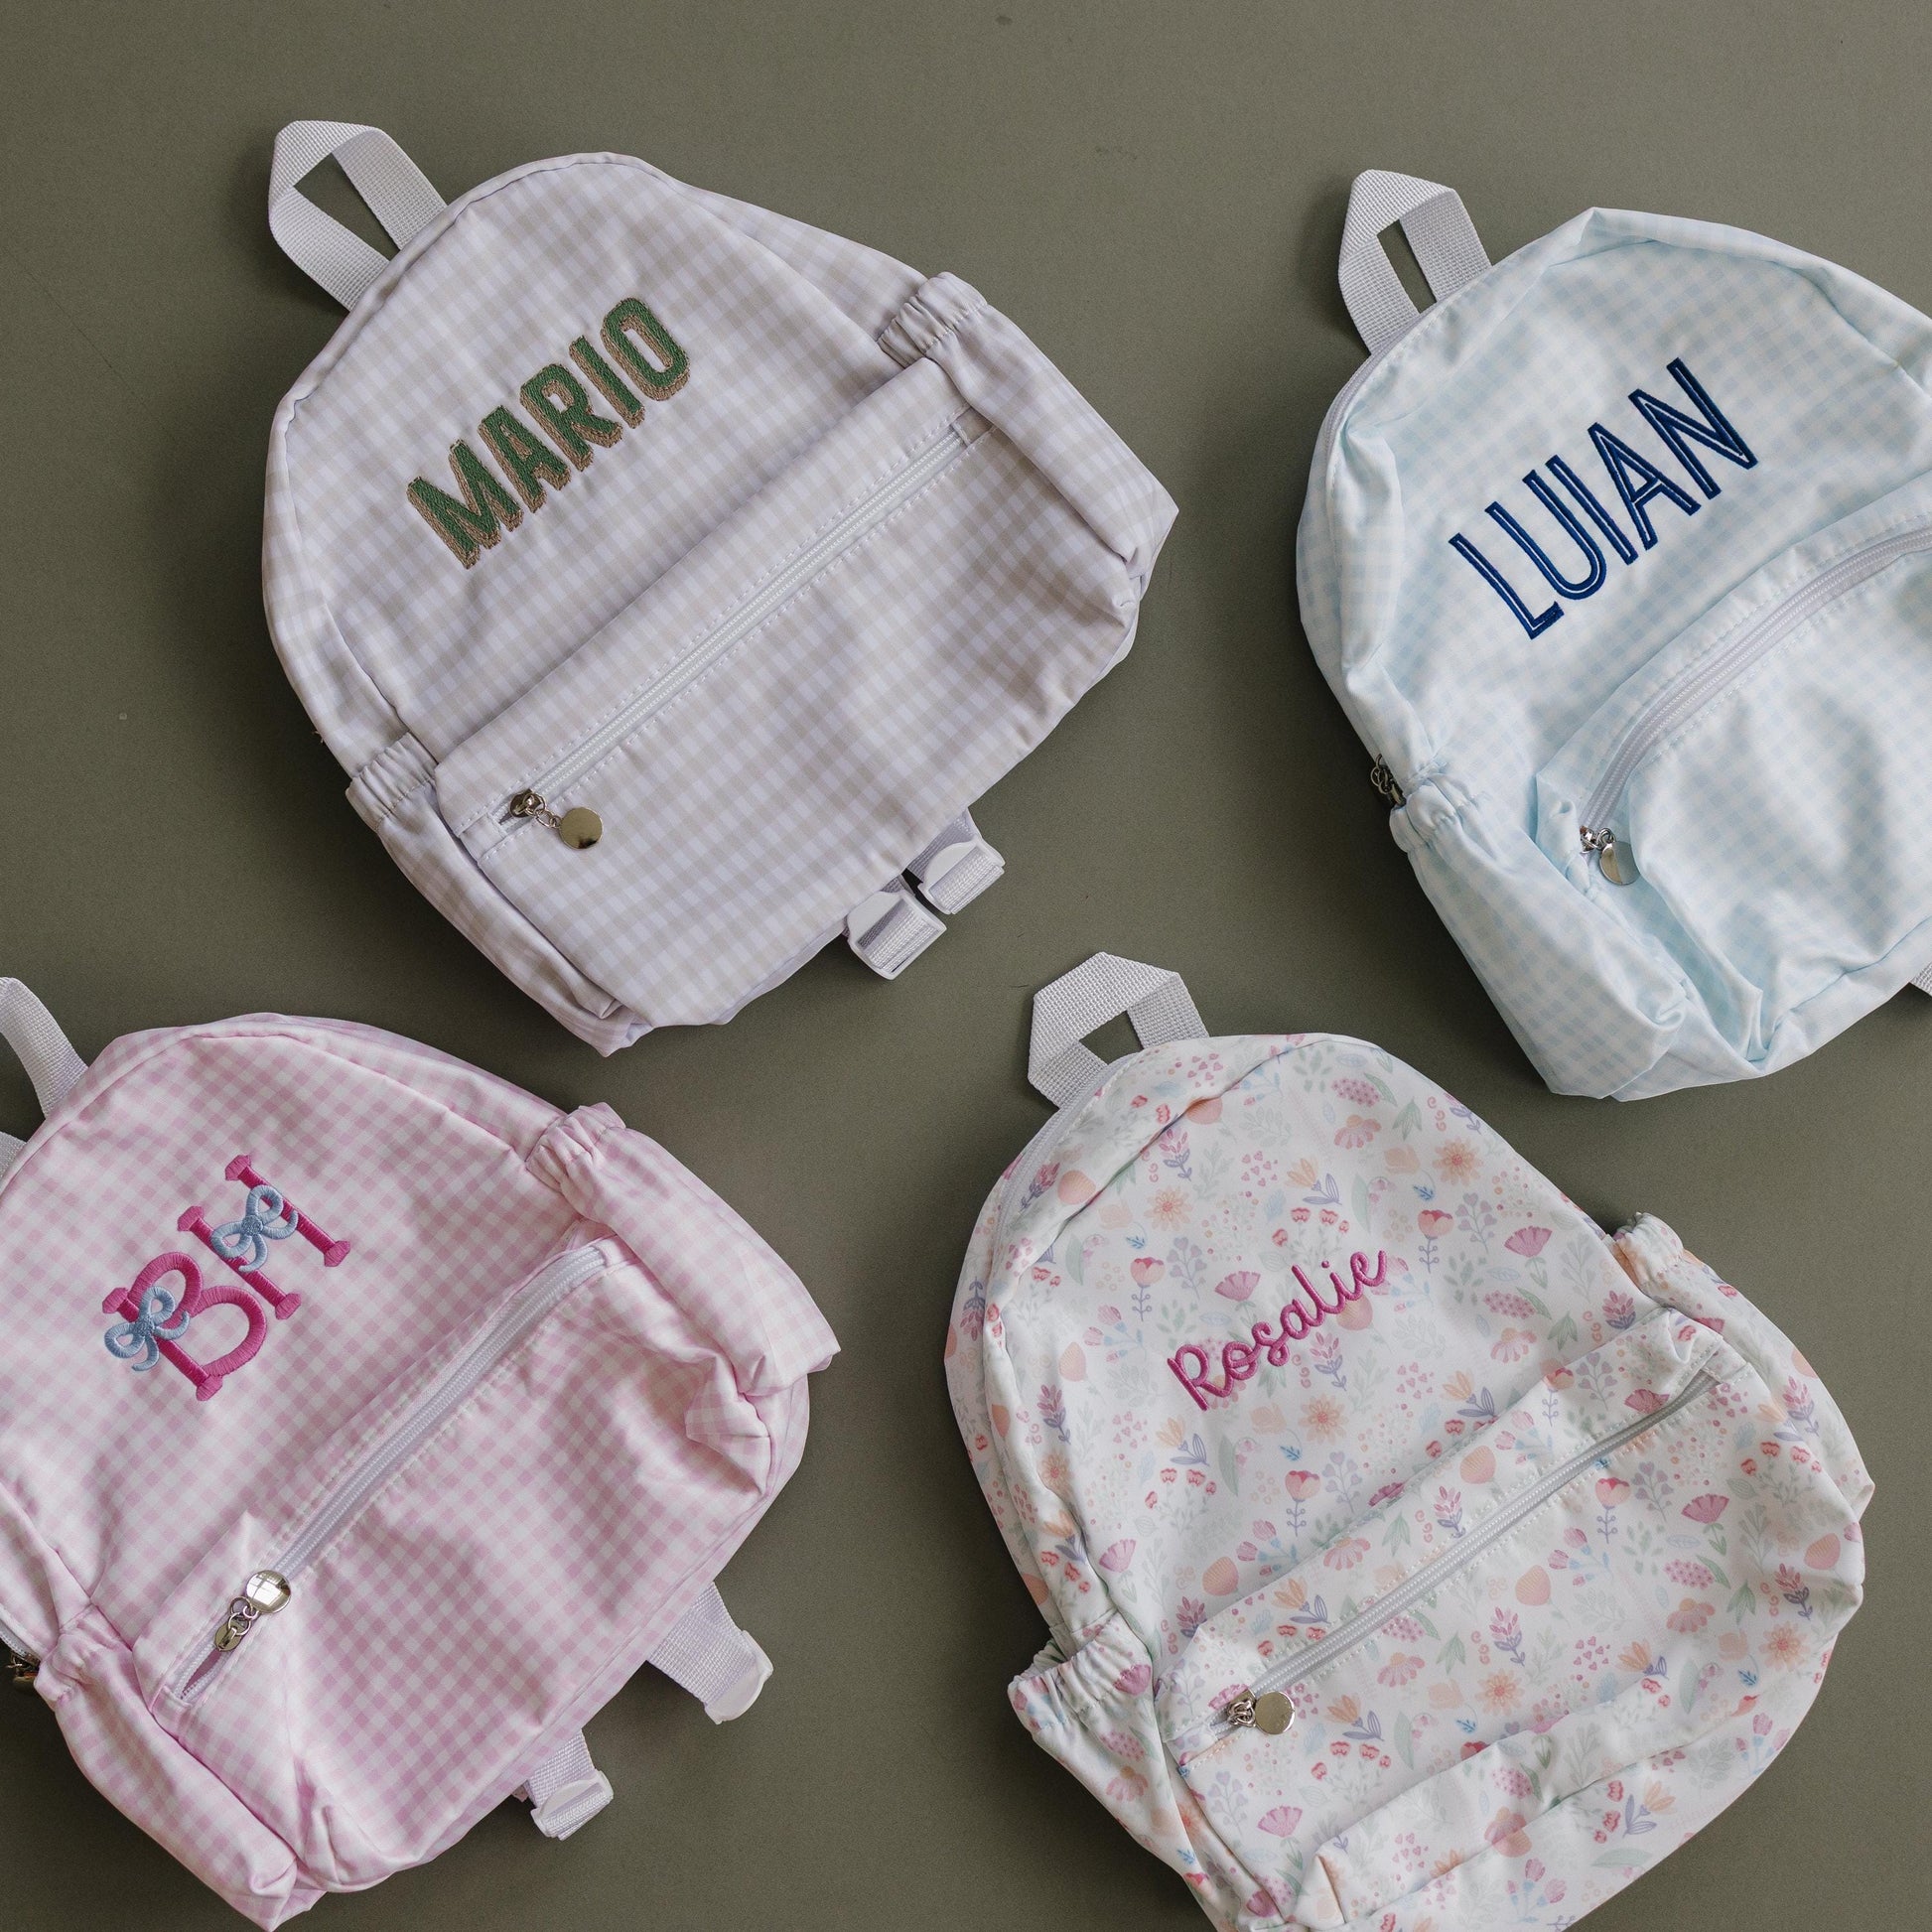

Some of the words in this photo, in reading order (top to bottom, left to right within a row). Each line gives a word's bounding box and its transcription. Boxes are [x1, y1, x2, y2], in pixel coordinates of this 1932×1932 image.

[406, 297, 690, 570] MARIO
[1449, 356, 1758, 640] LUIAN
[1167, 1250, 1387, 1411] Rosalie
